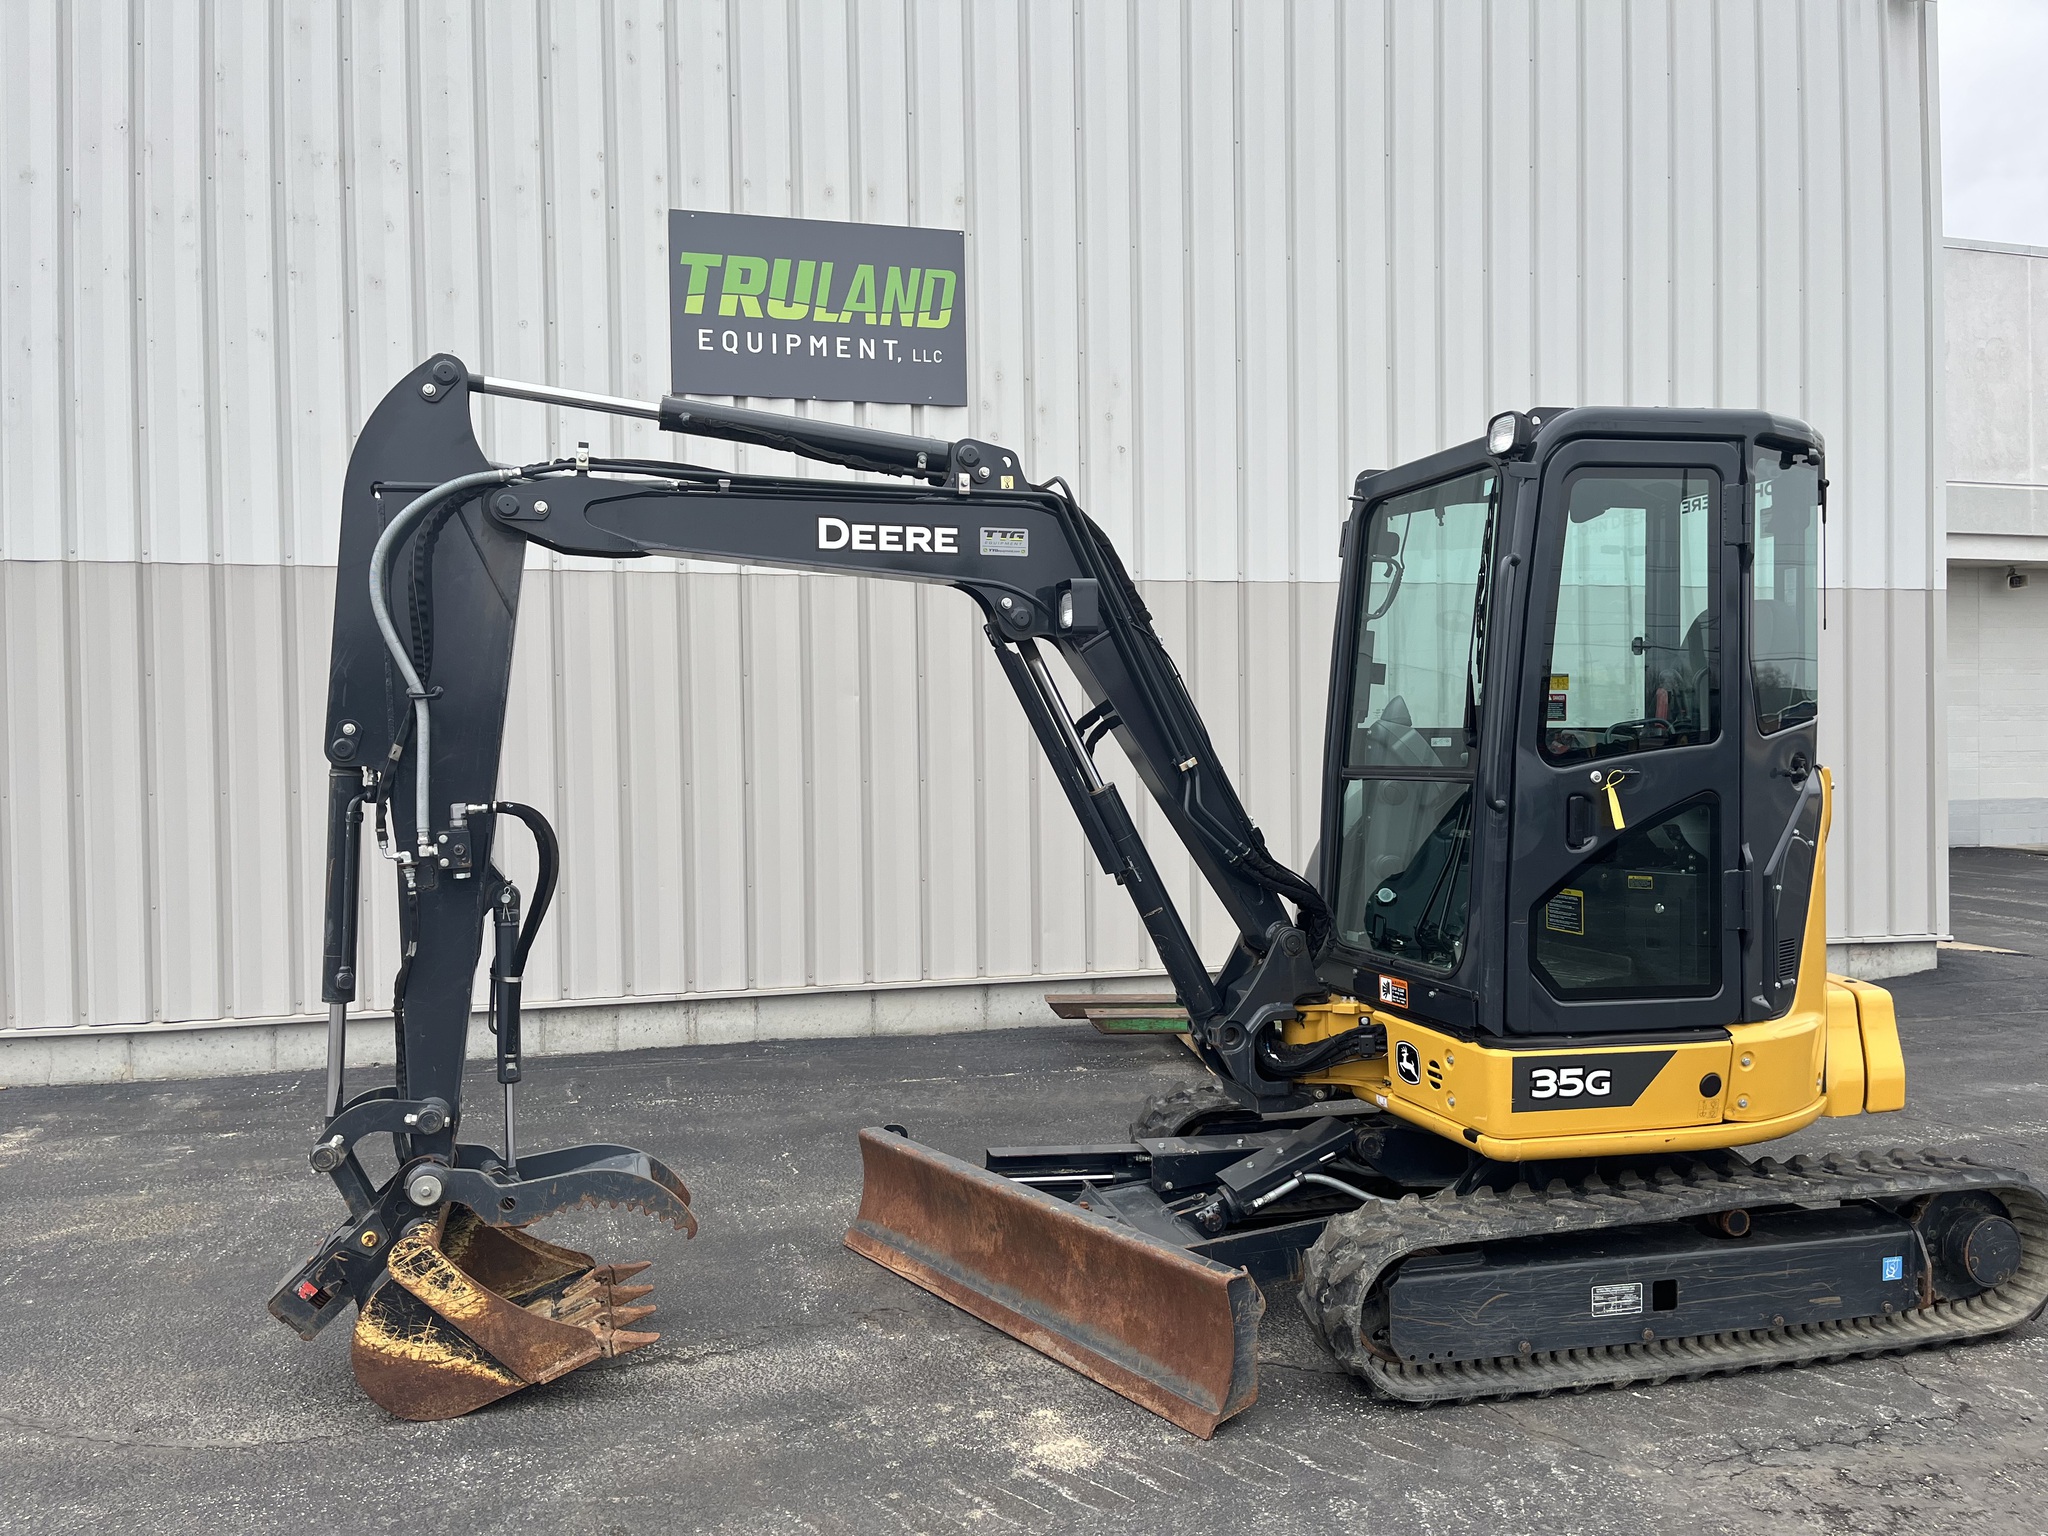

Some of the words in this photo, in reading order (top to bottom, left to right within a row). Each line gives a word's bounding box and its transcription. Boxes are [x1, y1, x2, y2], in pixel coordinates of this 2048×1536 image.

[680, 252, 957, 329] TRULAND
[698, 329, 902, 363] EQUIPMENT,
[912, 349, 943, 363] LLC
[818, 517, 959, 553] DEERE
[984, 530, 1025, 541] TTG
[1531, 1067, 1611, 1099] 35G
